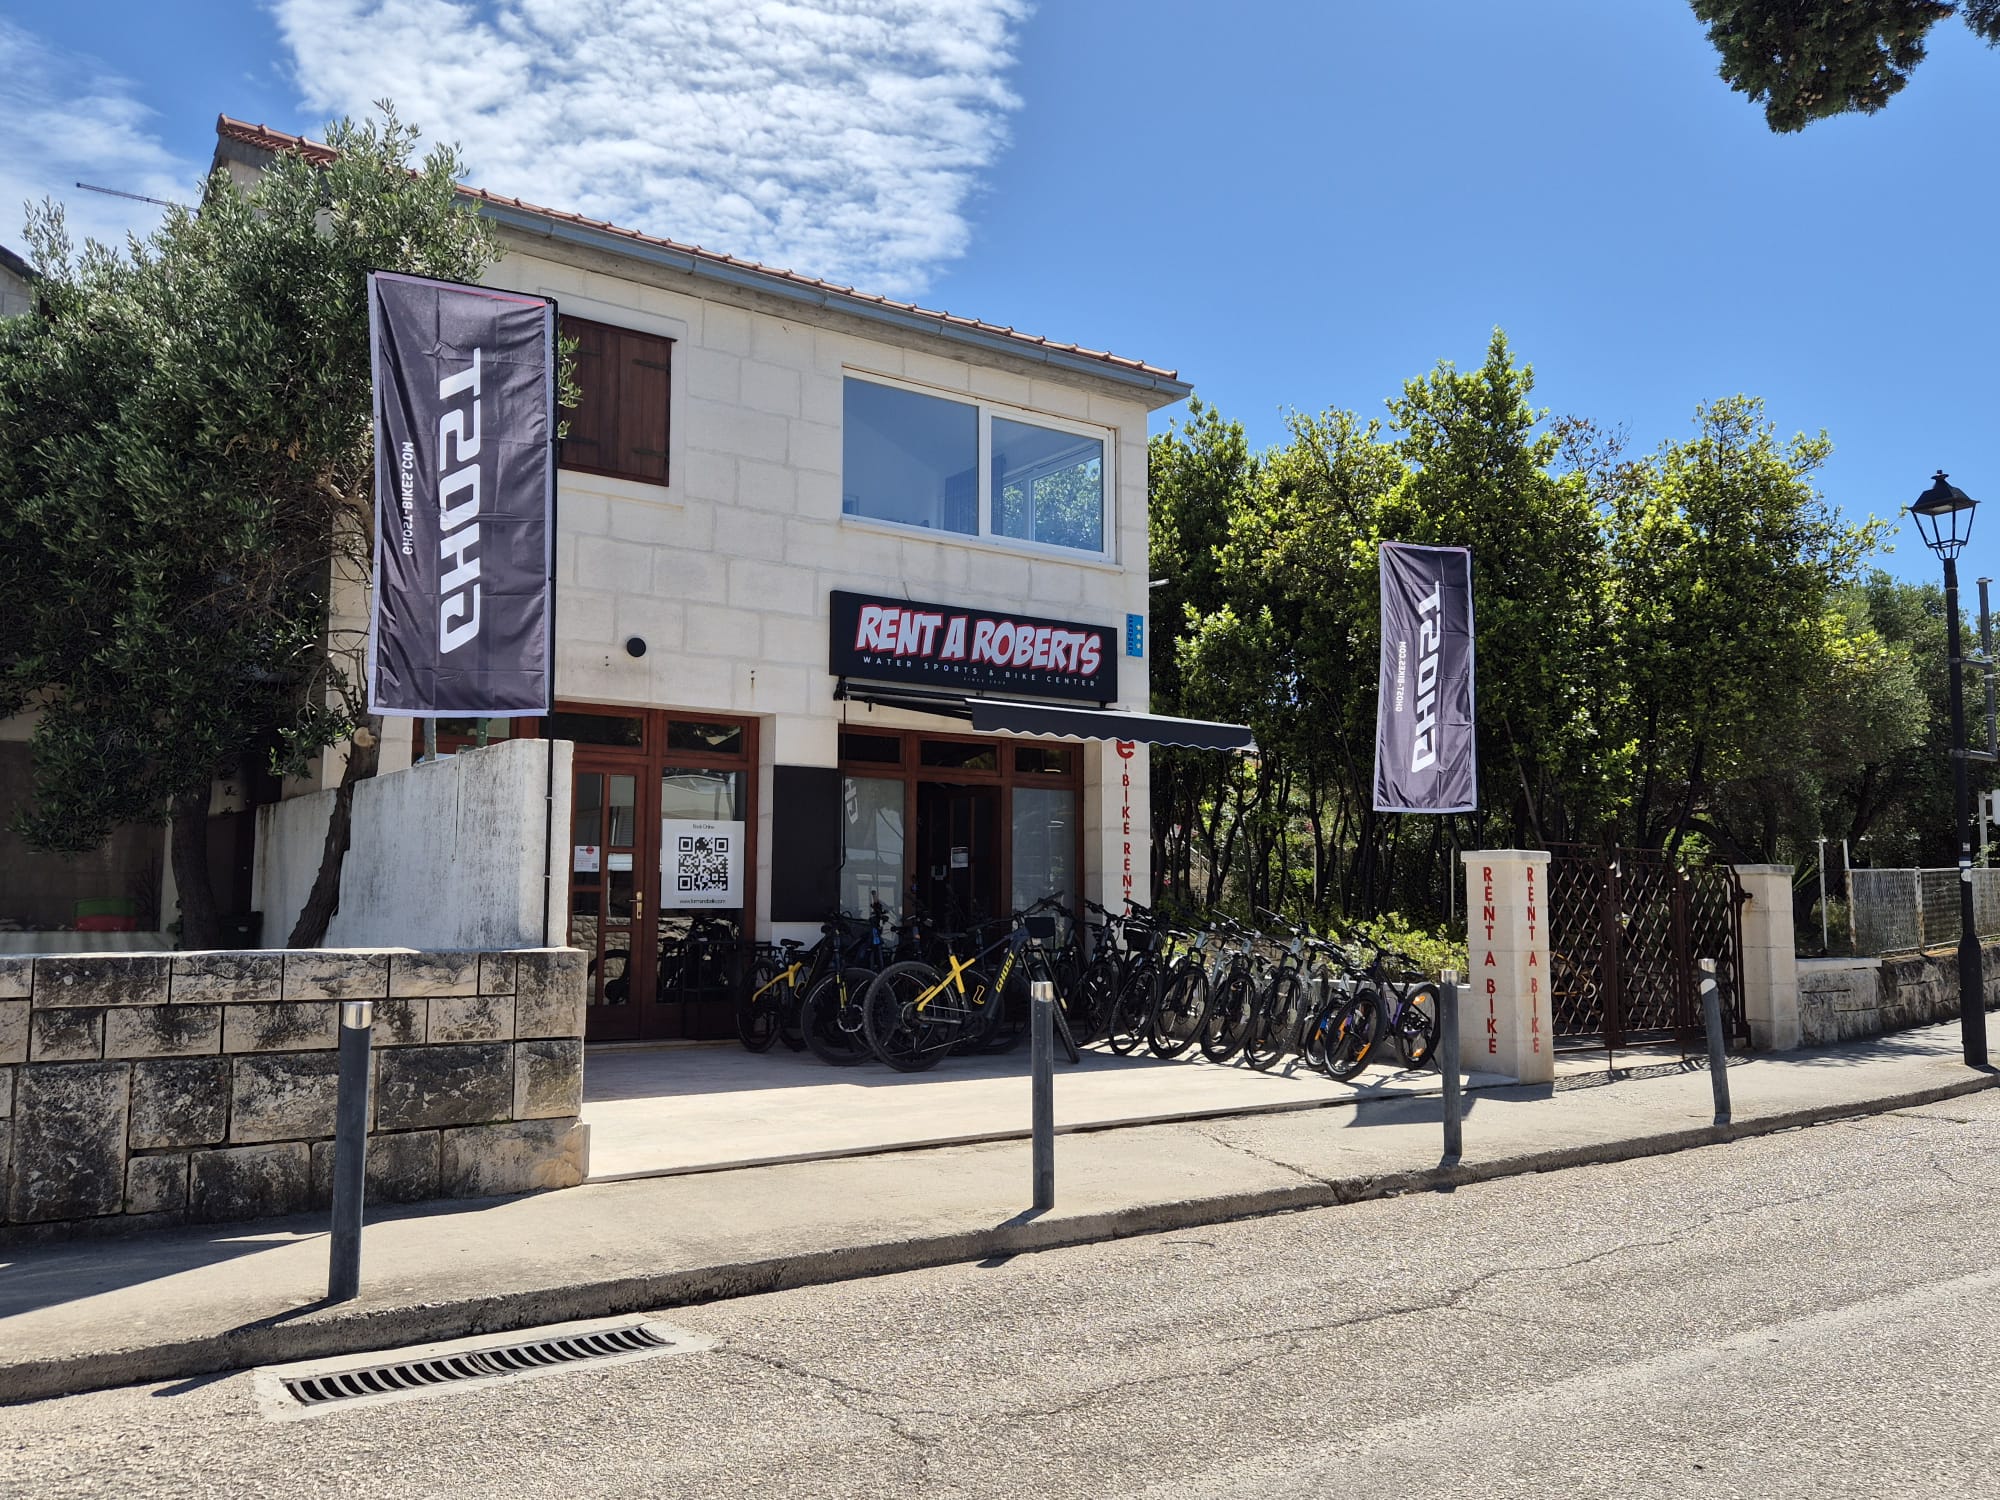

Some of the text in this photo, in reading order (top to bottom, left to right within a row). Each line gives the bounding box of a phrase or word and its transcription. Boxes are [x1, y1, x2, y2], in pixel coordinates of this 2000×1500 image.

[854, 604, 1102, 677] RENT A ROBERTS
[863, 656, 912, 668] WATER
[924, 663, 978, 675] SPORTS
[1006, 671, 1036, 681] BIKE
[1046, 675, 1095, 687] CENTER
[1122, 841, 1132, 916] RENTA
[995, 951, 1015, 993] GHOST
[1483, 867, 1498, 1054] RENT A BIKE
[1526, 867, 1540, 1053] RENT A BIKE
